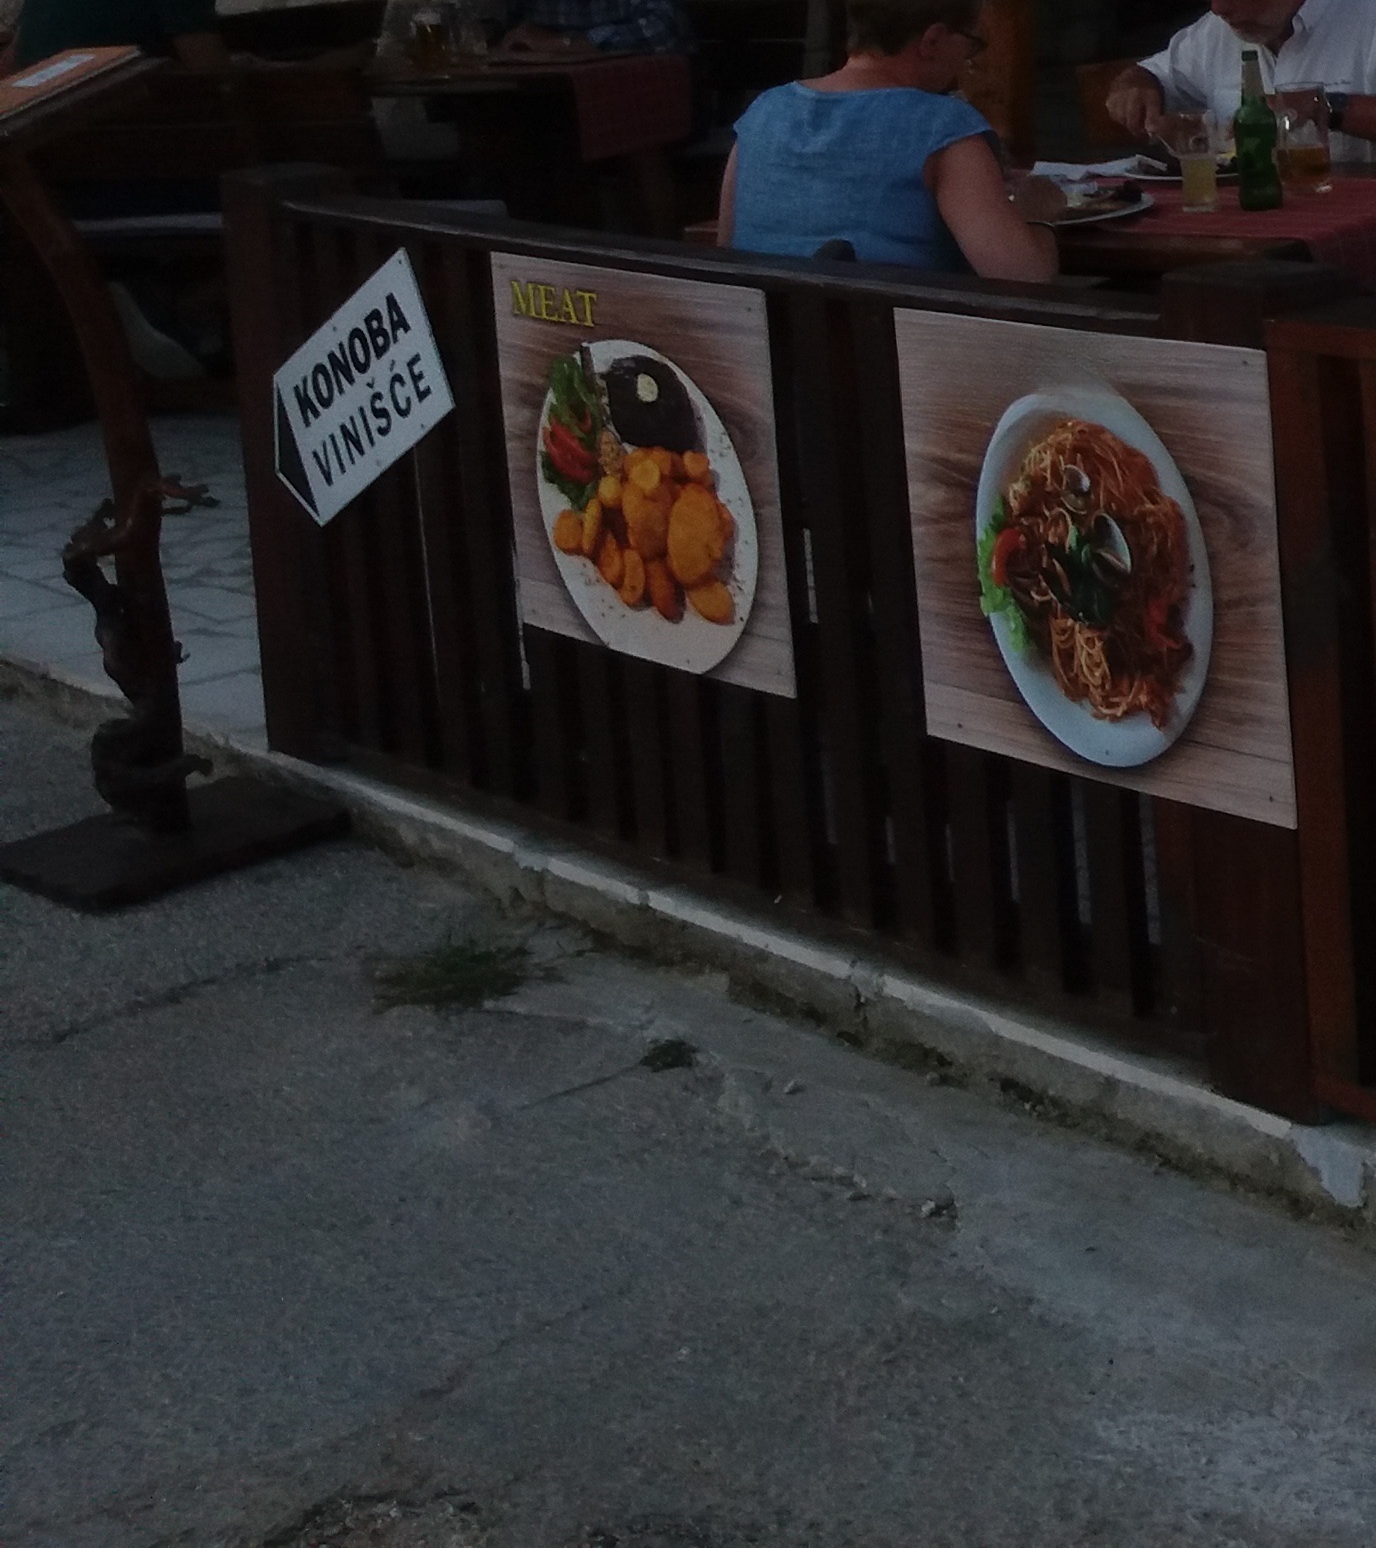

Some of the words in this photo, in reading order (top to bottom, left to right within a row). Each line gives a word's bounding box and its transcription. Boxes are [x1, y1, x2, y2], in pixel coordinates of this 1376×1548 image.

[293, 290, 411, 428] KONOBA
[511, 281, 598, 328] MEAT
[311, 353, 434, 488] VINIŠĆE
